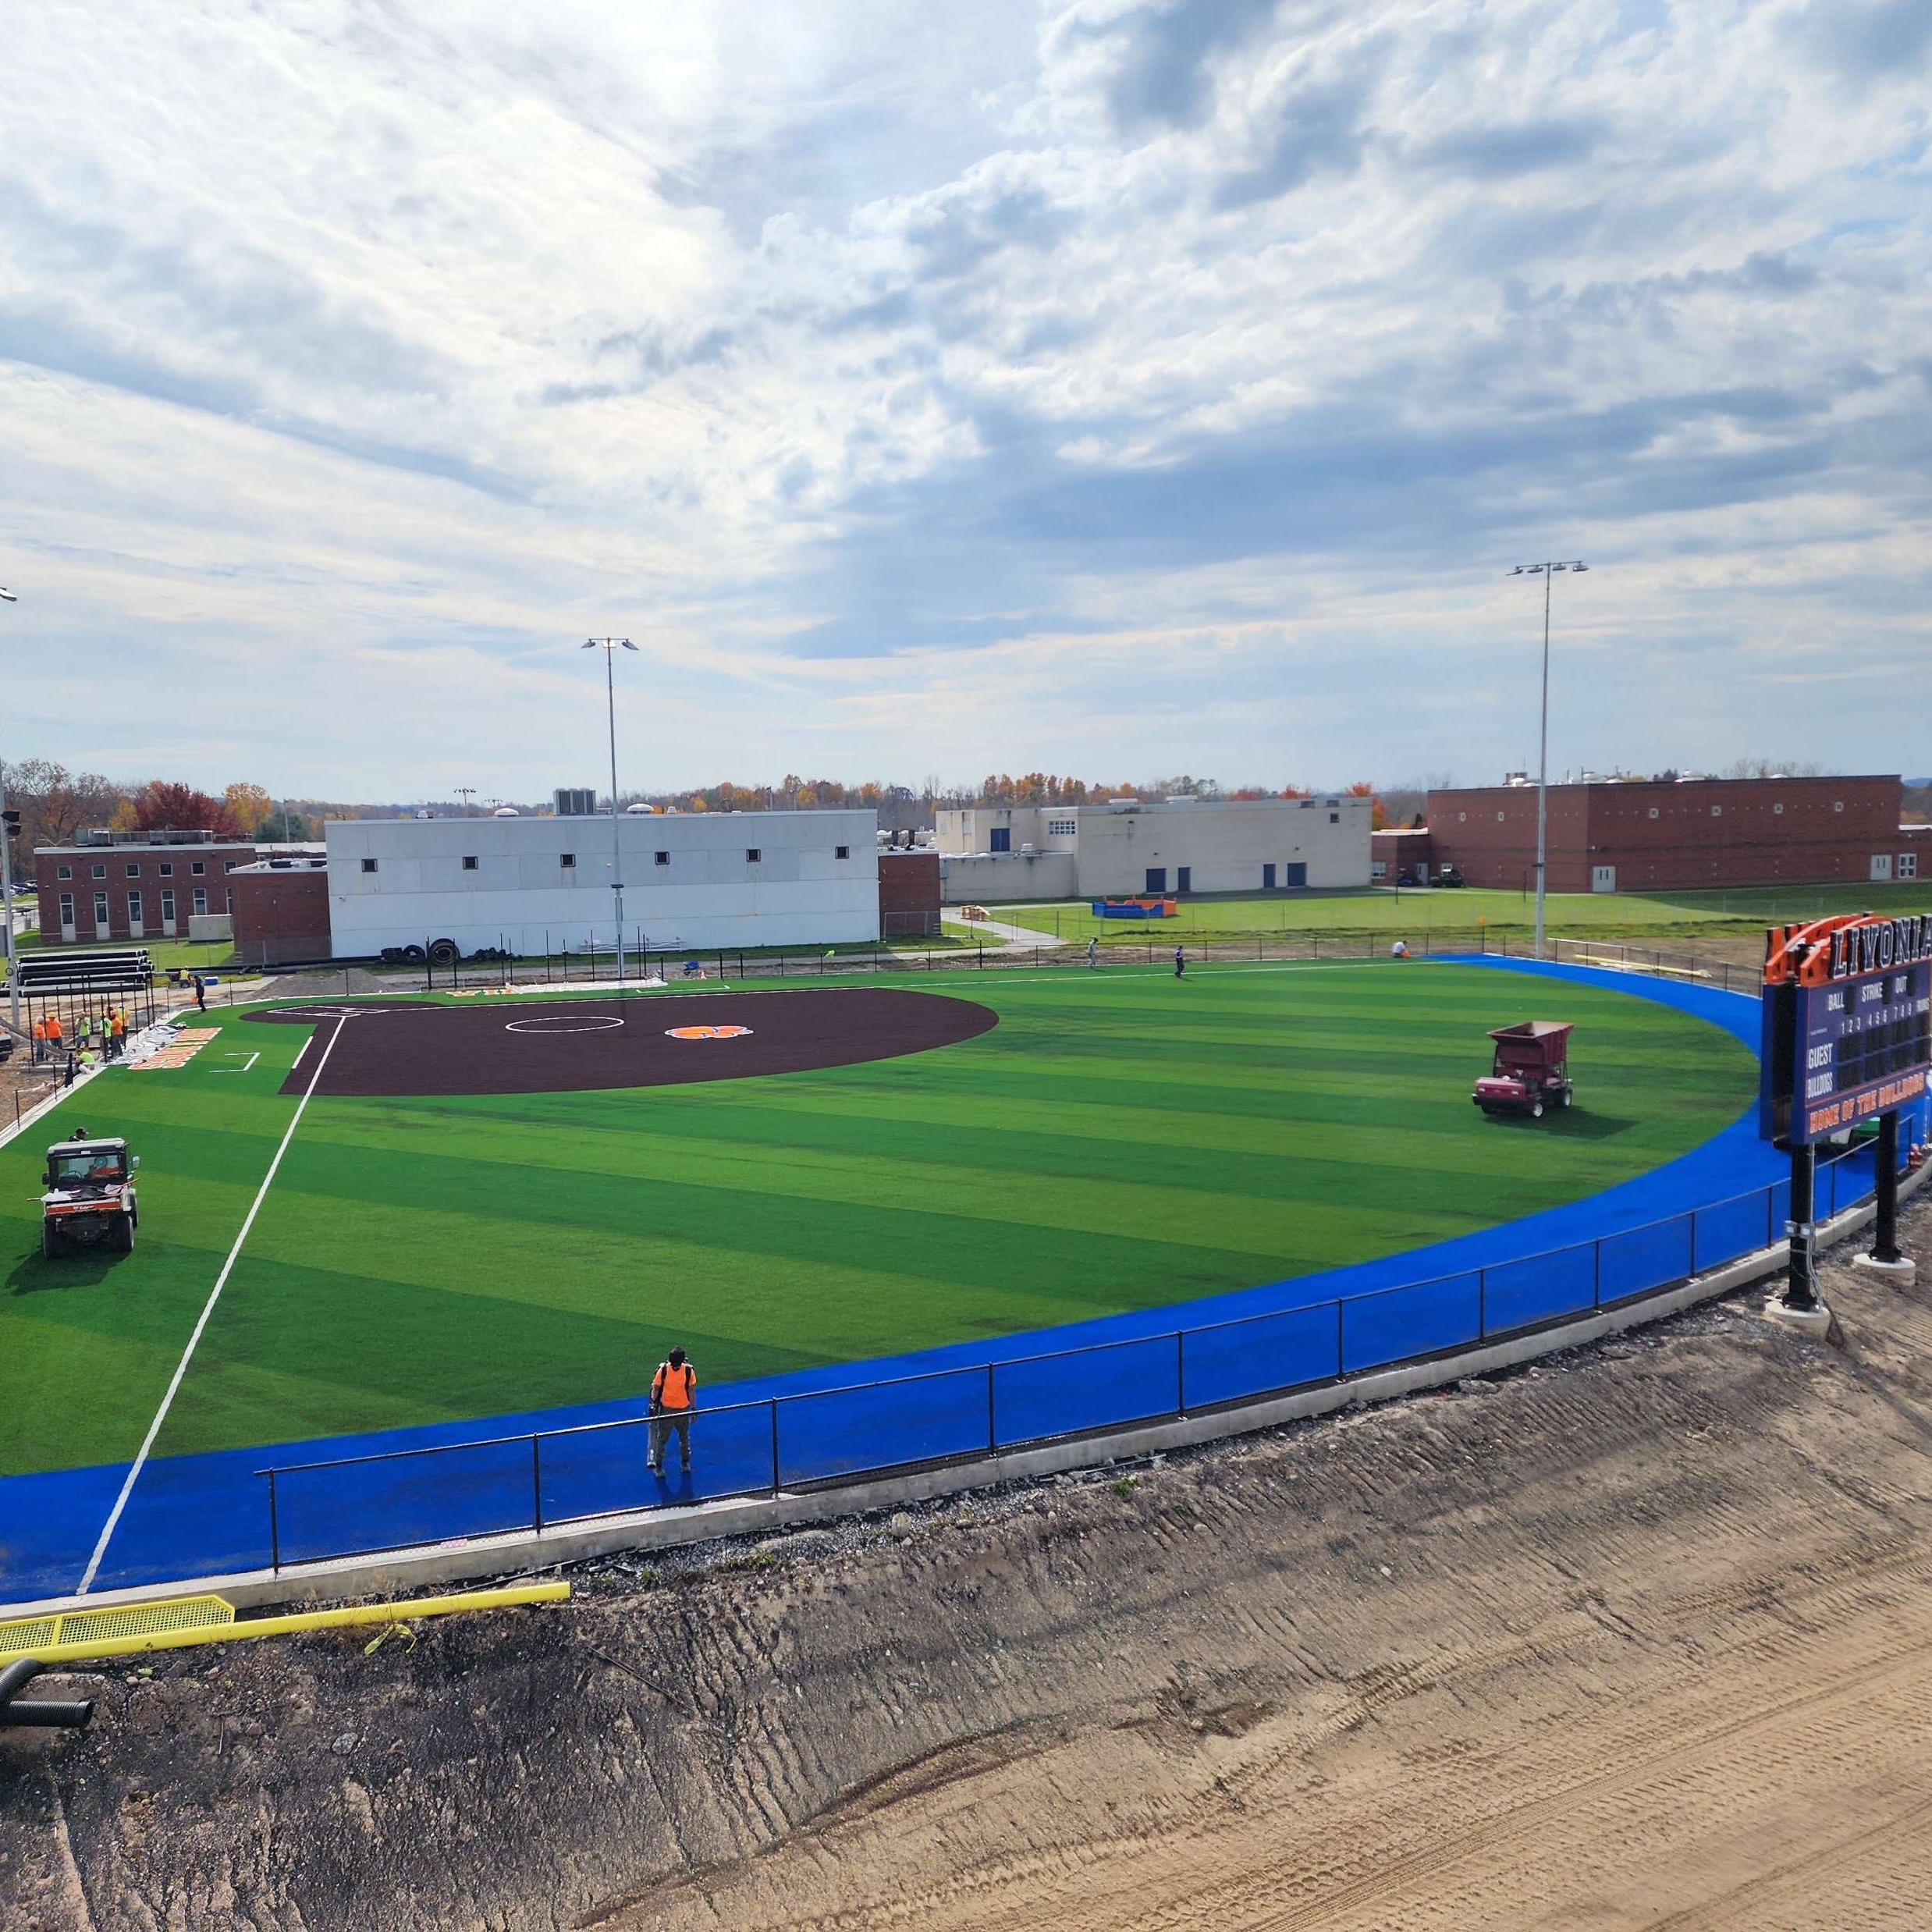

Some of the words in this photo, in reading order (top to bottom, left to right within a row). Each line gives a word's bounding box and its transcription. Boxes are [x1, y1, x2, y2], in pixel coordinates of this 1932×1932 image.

[1831, 914, 1932, 979] LIVONIA
[1828, 992, 1844, 1011] BALL
[1862, 982, 1883, 1003] STRIKE
[1895, 975, 1908, 993] OUT
[1809, 1043, 1833, 1070] GUEST
[1807, 1071, 1833, 1099] BULLDOGS
[1810, 1103, 1840, 1134] HOME
[1841, 1098, 1855, 1121] OF
[1856, 1090, 1877, 1115] THE
